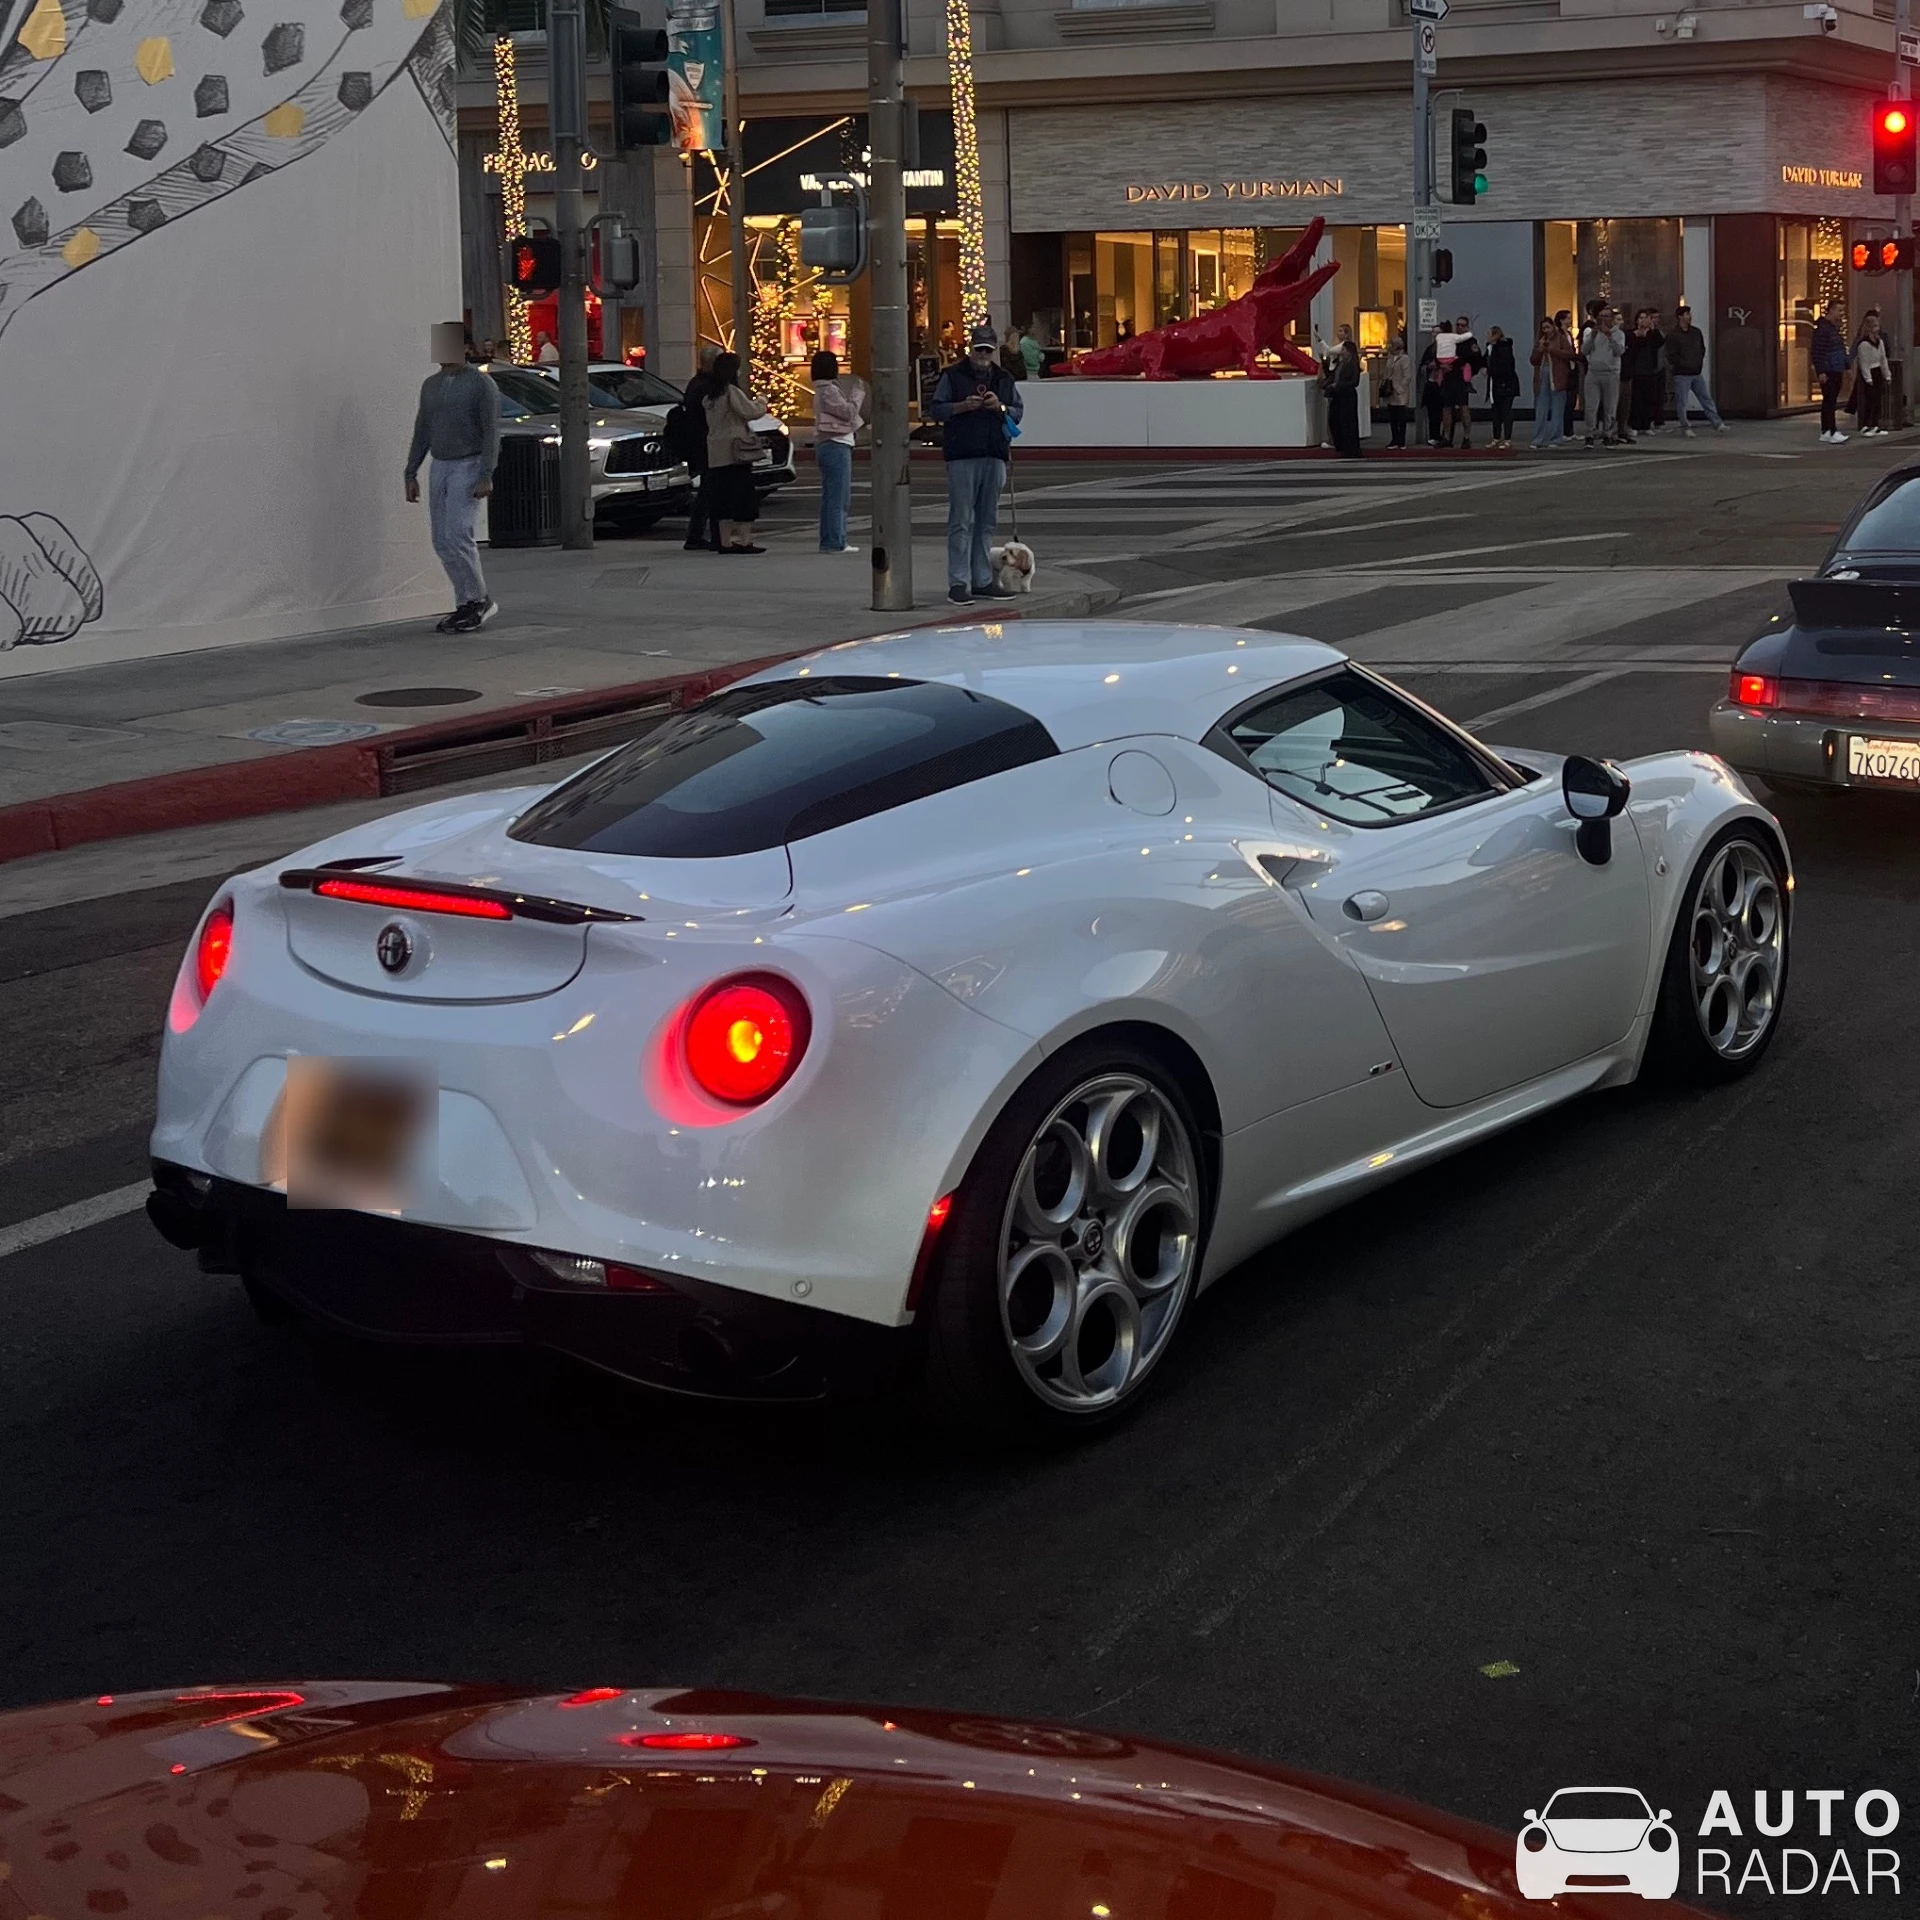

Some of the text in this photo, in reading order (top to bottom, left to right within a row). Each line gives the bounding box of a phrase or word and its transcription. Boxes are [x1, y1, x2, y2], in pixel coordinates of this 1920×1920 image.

[1782, 166, 1818, 185] DAVID
[1126, 178, 1343, 204] DAVID YURMAN
